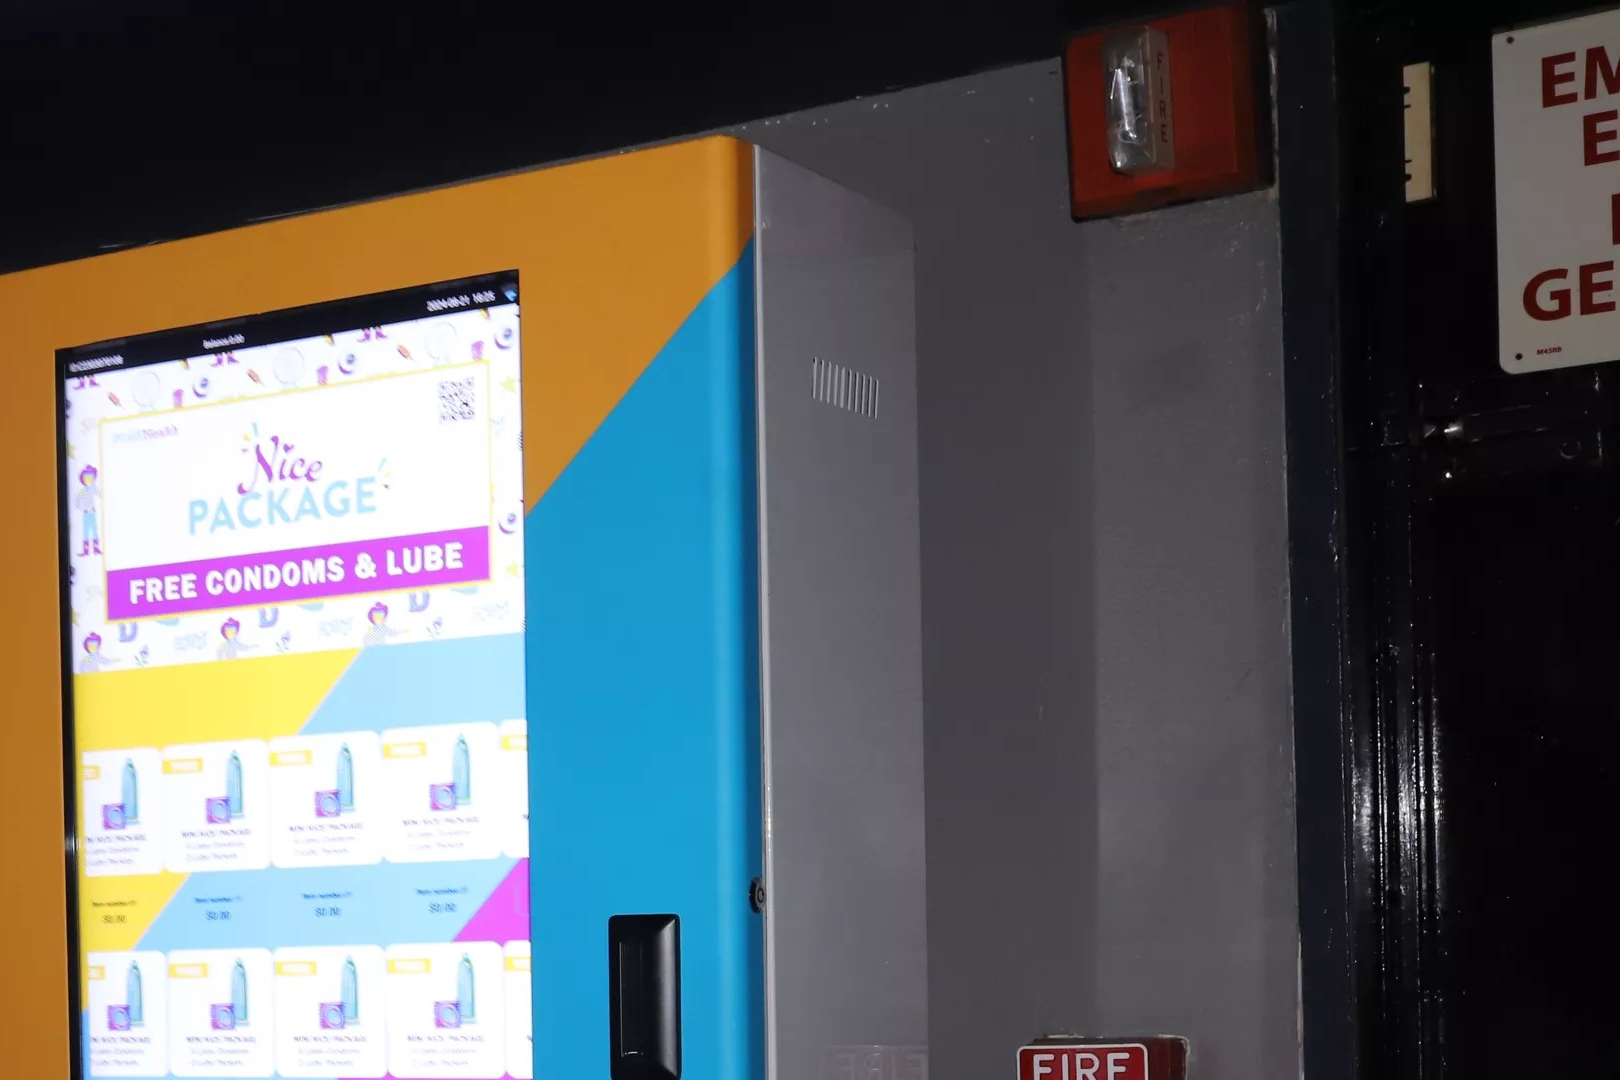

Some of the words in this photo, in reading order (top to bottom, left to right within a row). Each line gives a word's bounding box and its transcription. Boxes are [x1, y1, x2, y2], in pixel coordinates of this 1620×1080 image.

[1156, 52, 1168, 144] FIRE
[1523, 260, 1616, 321] GE
[237, 435, 323, 495] Nice
[188, 474, 378, 535] PACKAGE
[128, 573, 198, 604] FREE
[205, 553, 345, 596] CONDOMS
[354, 552, 377, 579] &
[386, 542, 464, 575] LUBE
